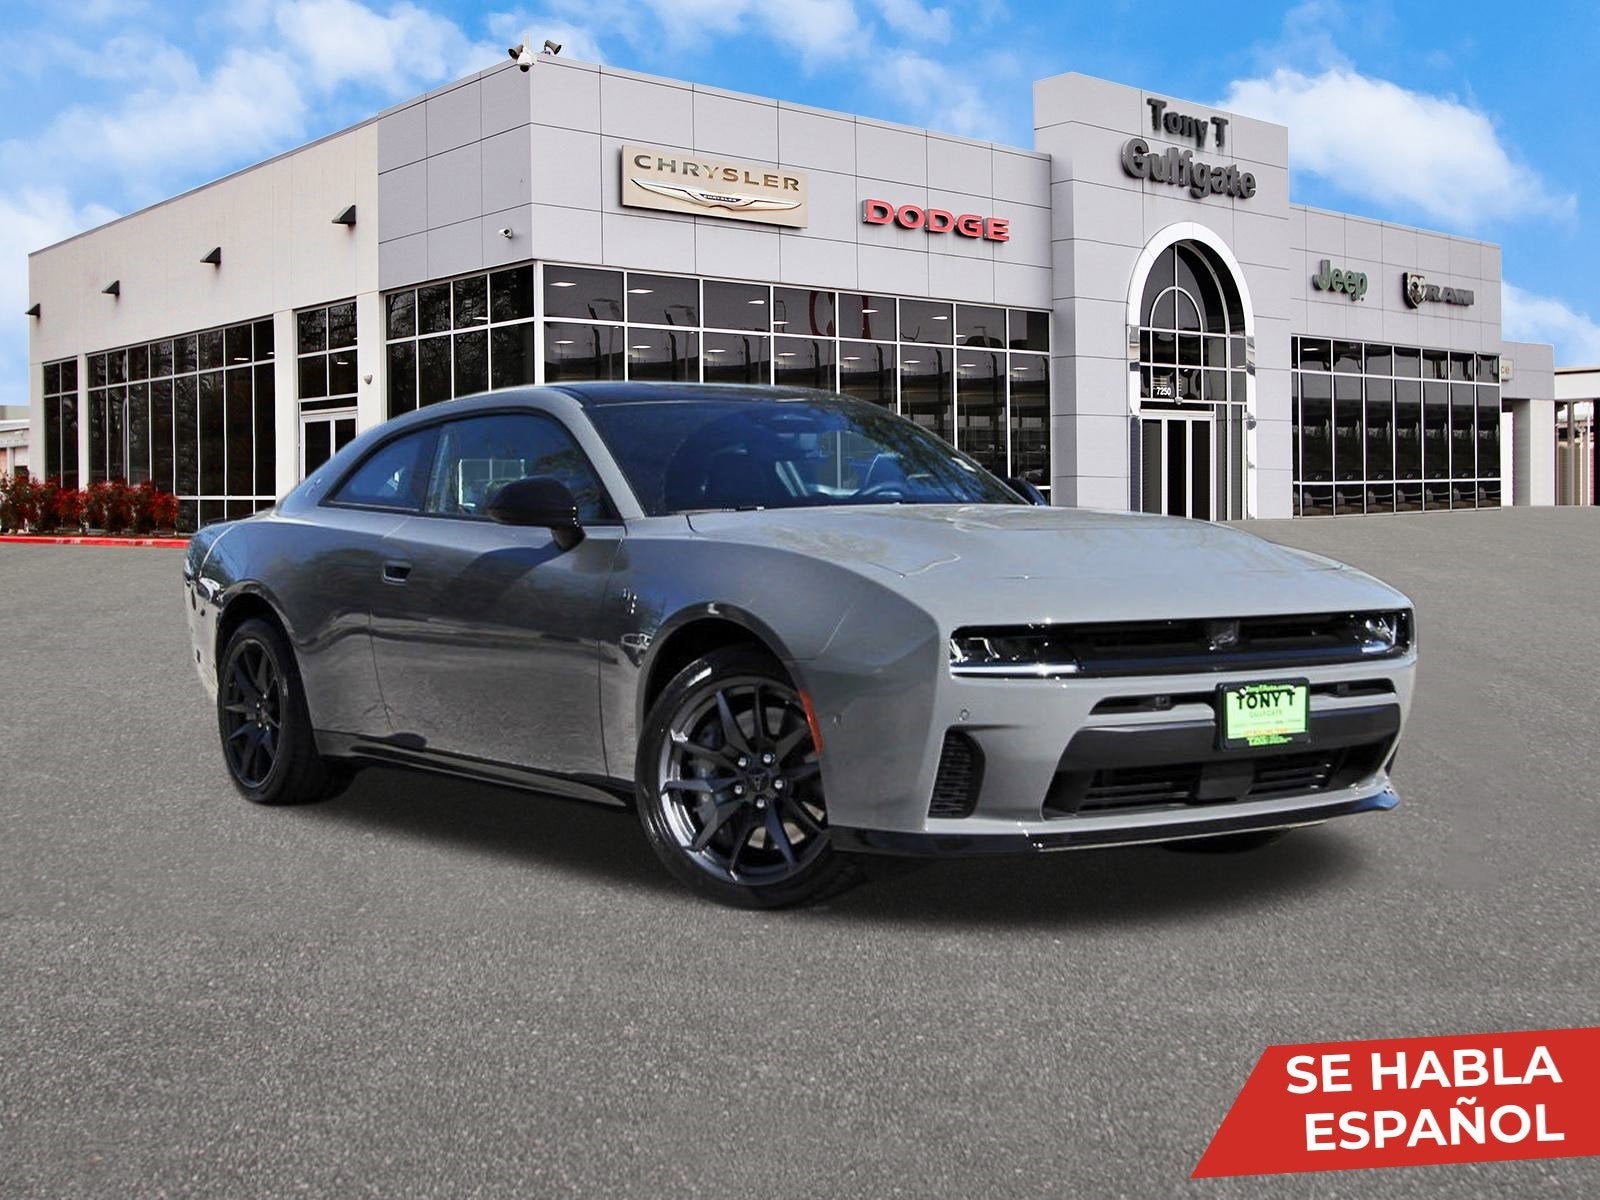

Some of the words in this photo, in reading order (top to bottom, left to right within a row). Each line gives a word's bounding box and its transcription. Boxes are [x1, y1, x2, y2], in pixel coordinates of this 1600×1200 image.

[1147, 98, 1208, 147] Tony
[1210, 116, 1229, 147] T
[633, 154, 800, 191] CHRYSLER
[1121, 138, 1256, 199] Gulfgate
[862, 199, 1010, 242] DODGE
[1312, 259, 1368, 301] Jeep
[1425, 284, 1474, 306] RAM
[1156, 386, 1171, 396] 7250
[1236, 691, 1281, 709] TONY
[1286, 690, 1295, 706] T
